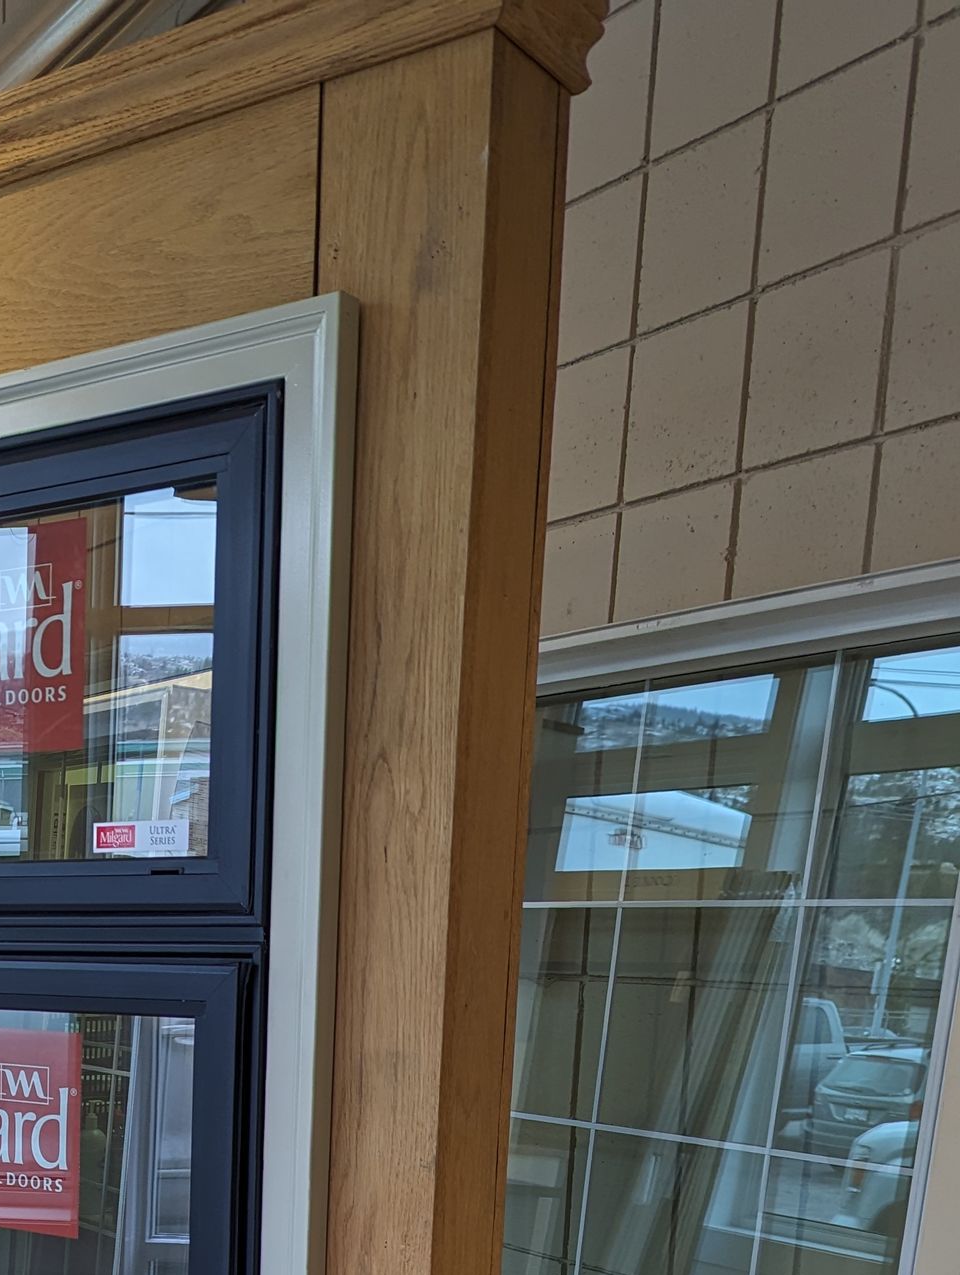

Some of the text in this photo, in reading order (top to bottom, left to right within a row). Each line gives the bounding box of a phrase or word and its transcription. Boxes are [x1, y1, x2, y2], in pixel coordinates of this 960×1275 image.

[5, 685, 67, 706] DOORS
[100, 829, 132, 847] Milgard
[149, 825, 176, 835] ULTRA
[150, 836, 176, 846] SERIES
[6, 1172, 64, 1193] DOORS
